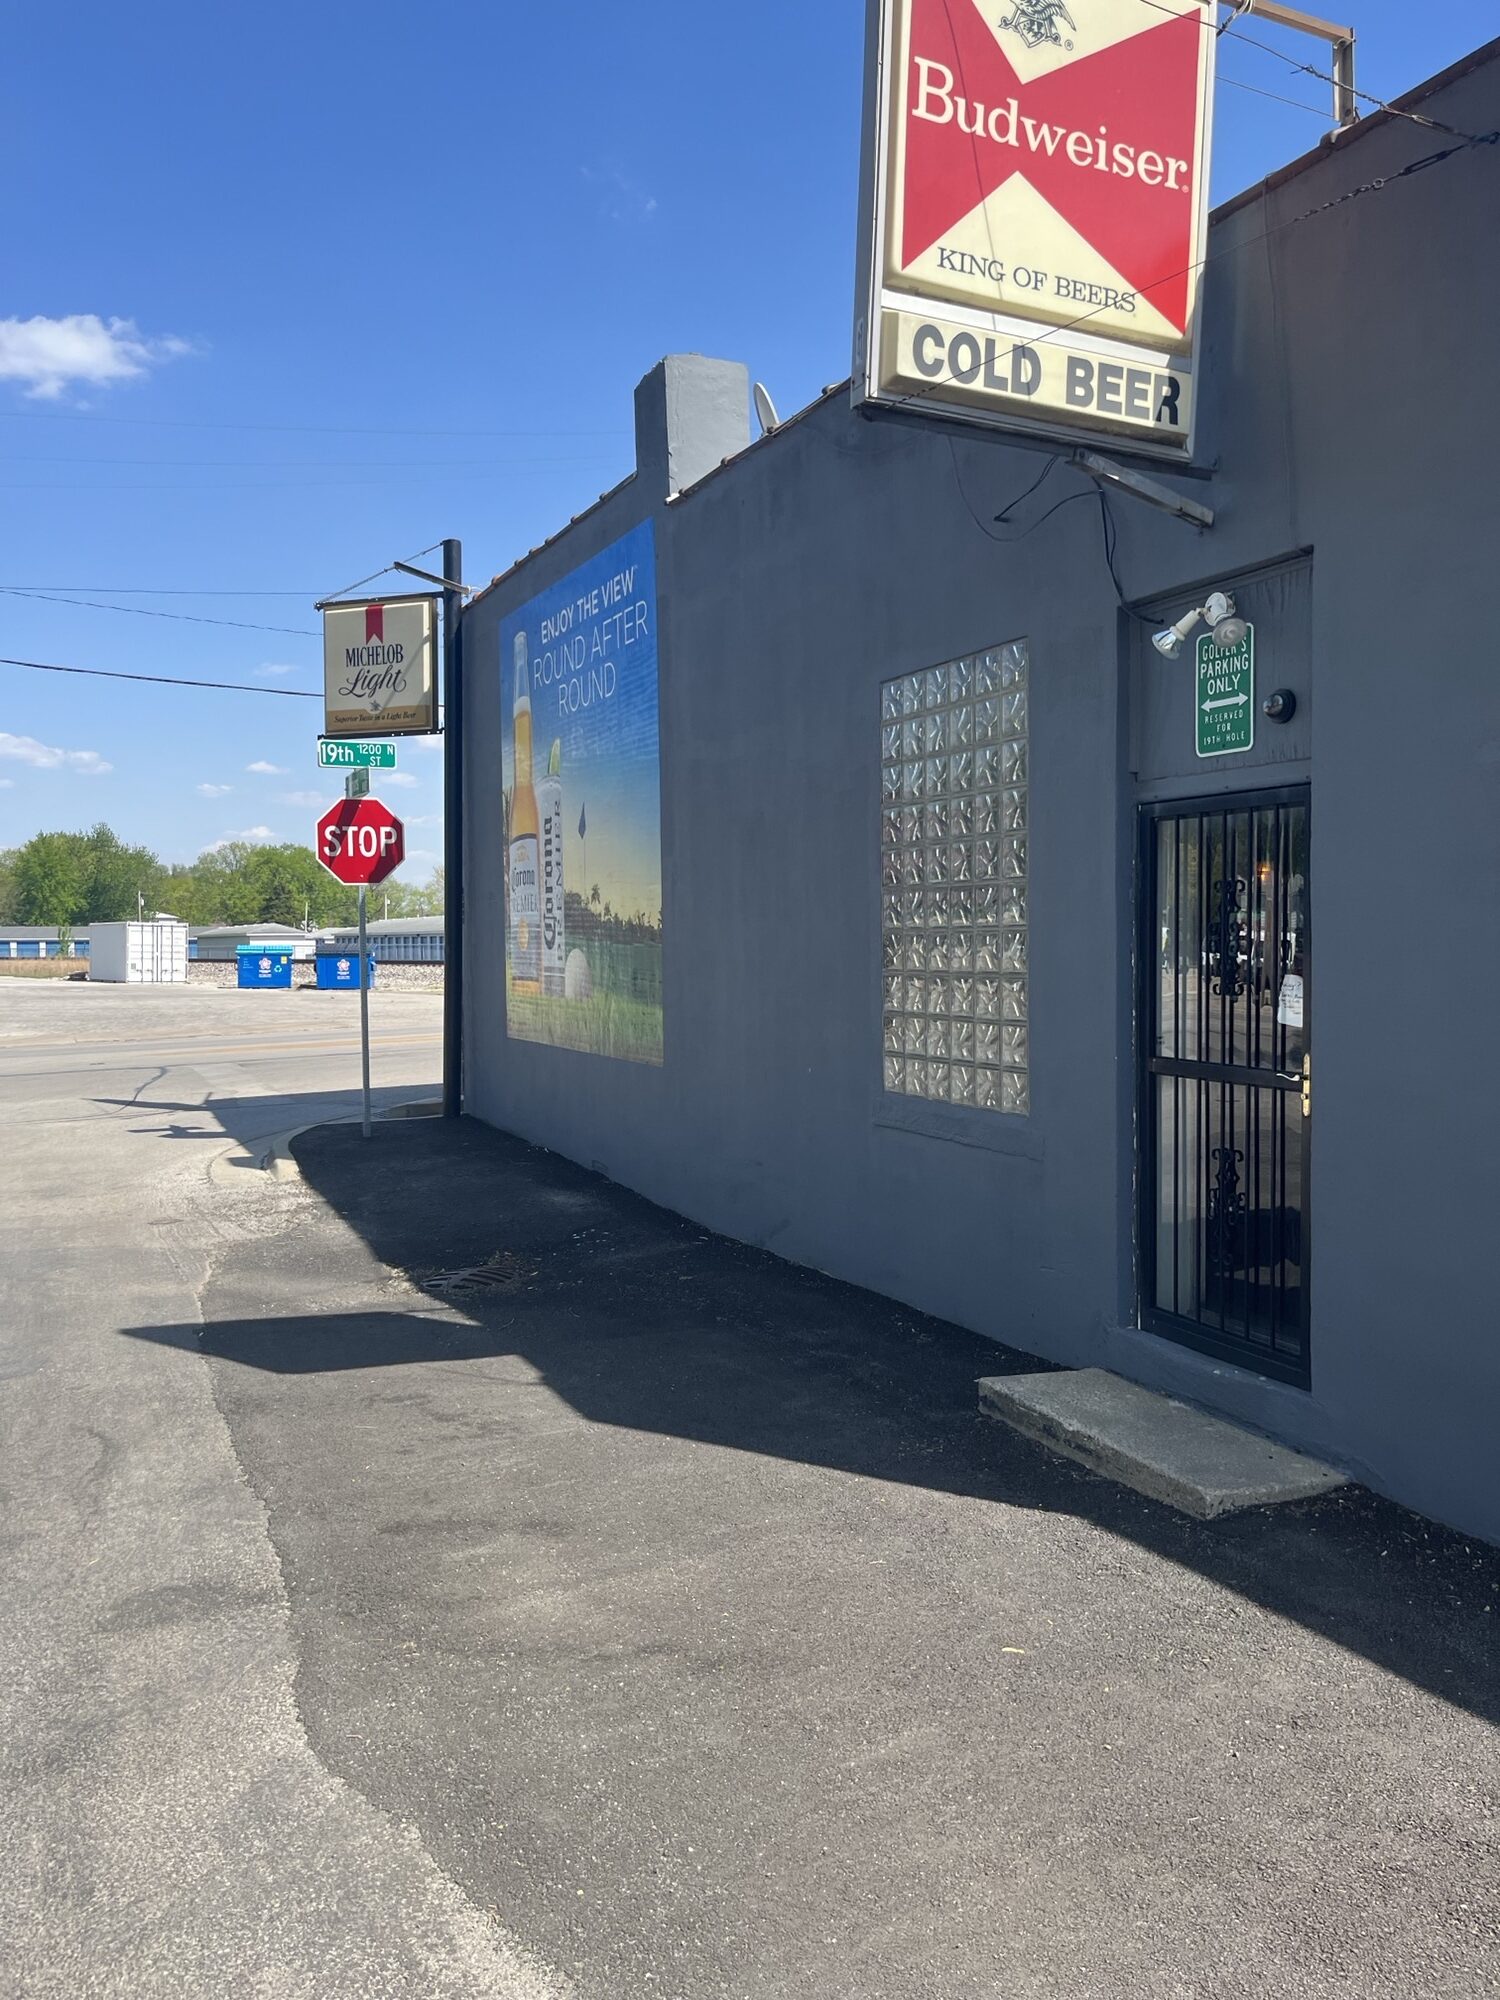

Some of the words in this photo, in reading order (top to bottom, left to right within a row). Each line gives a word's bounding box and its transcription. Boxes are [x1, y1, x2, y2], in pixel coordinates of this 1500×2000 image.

[912, 56, 1188, 190] Budweiser
[937, 247, 1005, 282] KING
[1013, 267, 1048, 291] OF
[1054, 277, 1136, 314] BEERS
[912, 324, 1042, 396] COLD
[1065, 356, 1181, 427] BEER
[541, 604, 574, 645] ENJOY
[577, 588, 599, 623] THE
[601, 566, 634, 609] VIEW
[345, 643, 404, 668] MICHELOB
[533, 635, 586, 691] ROUND
[590, 600, 648, 664] AFTER
[1203, 636, 1247, 661] GOLFERS
[1200, 653, 1249, 679] PARKING
[338, 664, 407, 699] Light
[559, 662, 616, 717] ROUND
[1207, 673, 1240, 695] ONLY
[1204, 709, 1244, 724] RESERVED
[1216, 722, 1231, 733] FOR
[1203, 735, 1221, 745] 19TH
[1226, 730, 1244, 742] HOLE
[321, 743, 354, 763] 19th
[358, 744, 382, 755] 1200
[386, 745, 394, 755] N
[369, 756, 382, 766] ST
[323, 825, 397, 857] STOP
[543, 816, 557, 950] Corona
